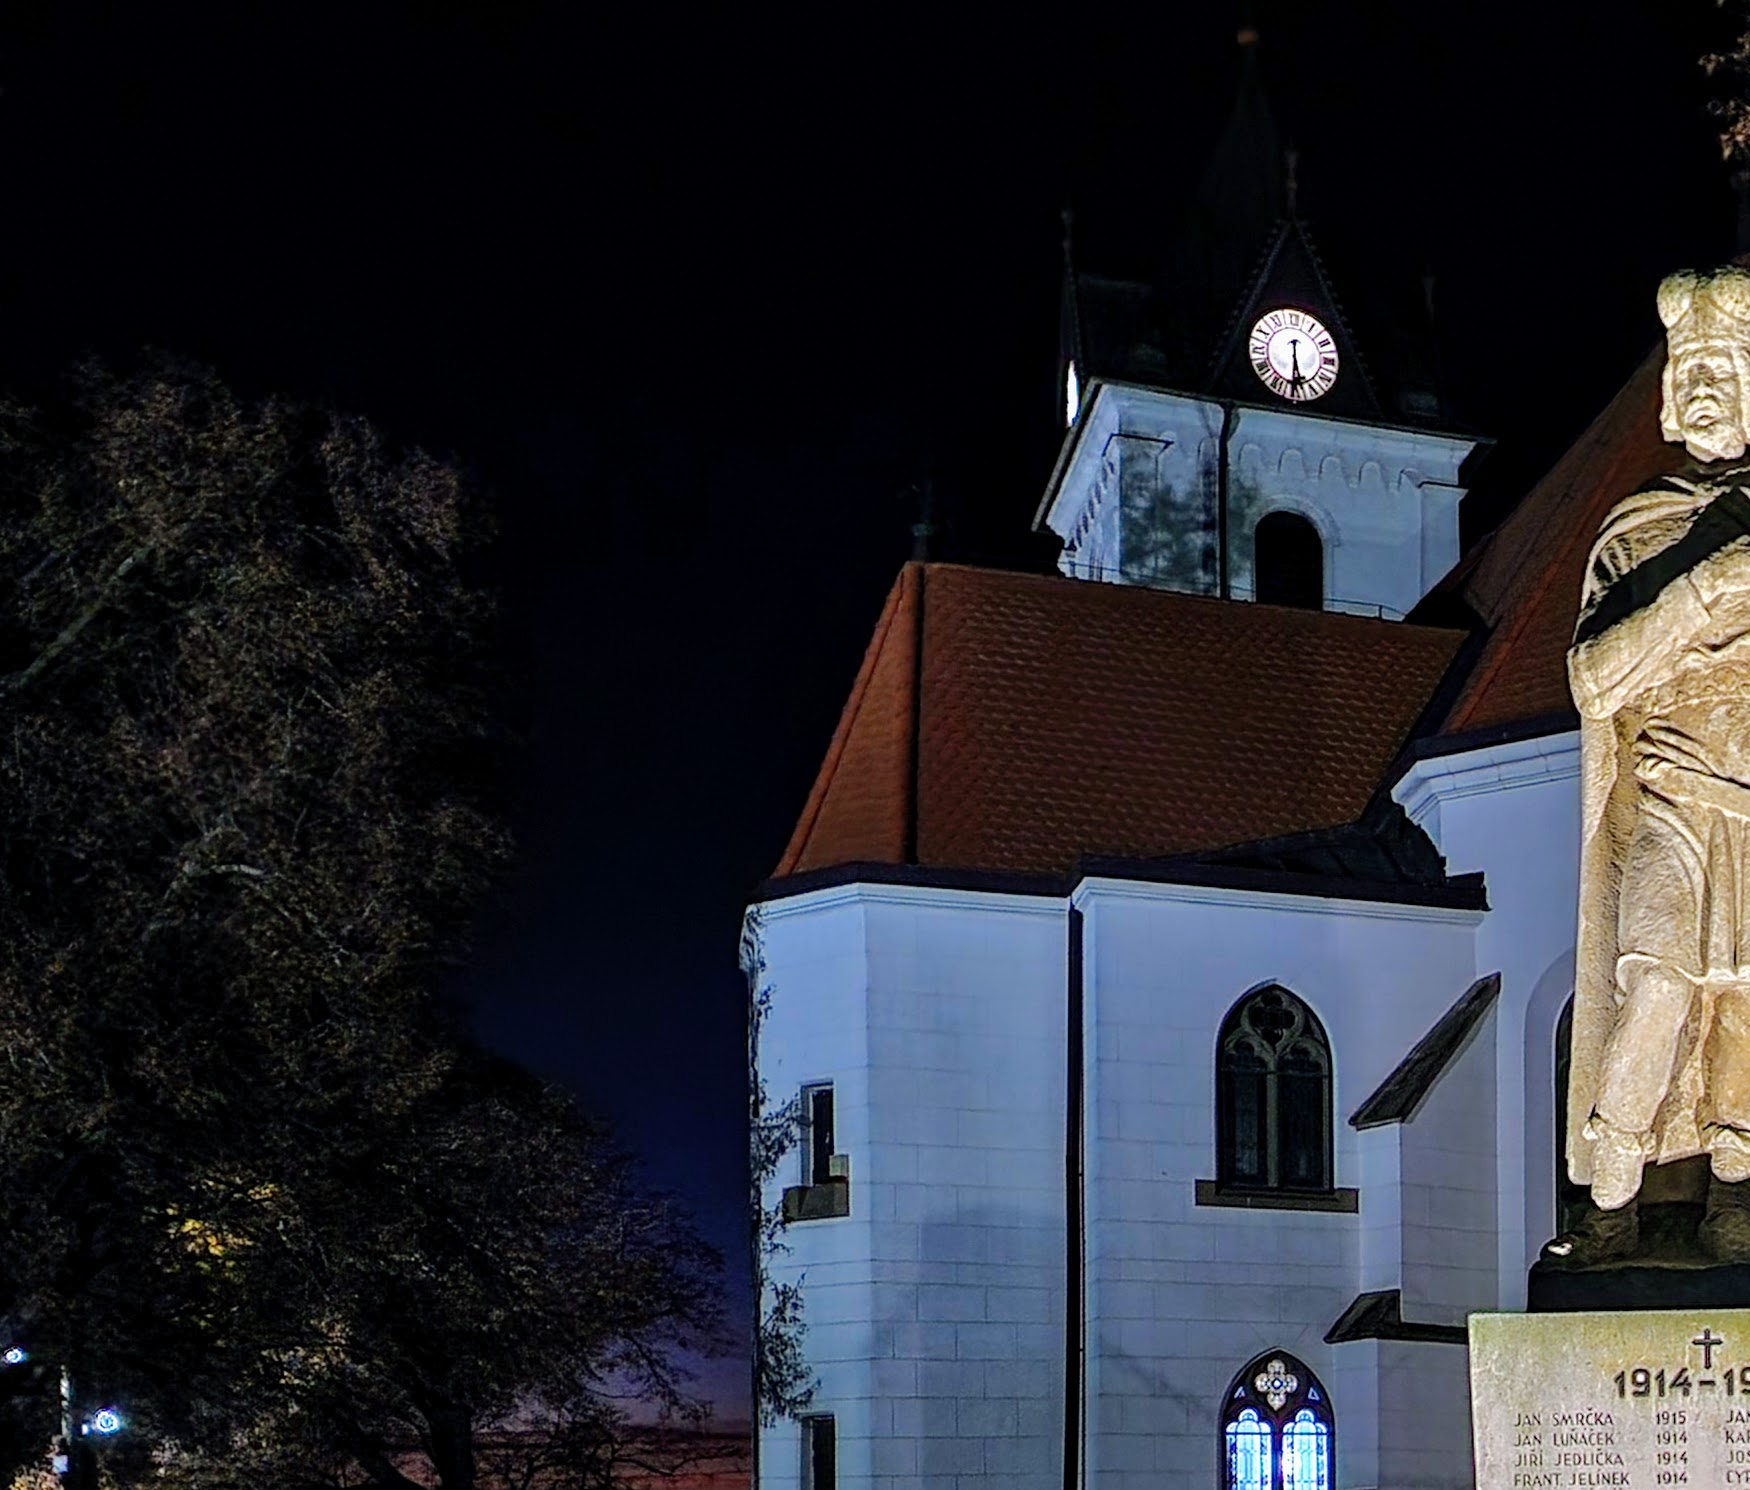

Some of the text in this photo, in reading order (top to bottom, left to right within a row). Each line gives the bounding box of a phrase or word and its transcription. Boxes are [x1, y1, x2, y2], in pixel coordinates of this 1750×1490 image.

[1514, 1407, 1686, 1427] JAN SMRČKA 1915
[1514, 1433, 1542, 1447] JAN
[1657, 1431, 1688, 1444] 1914
[1555, 1448, 1624, 1466] JEDLIČKA
[1657, 1451, 1688, 1465] 1914
[1568, 1469, 1630, 1485] JELÍNEK
[1657, 1473, 1689, 1485] 1914
